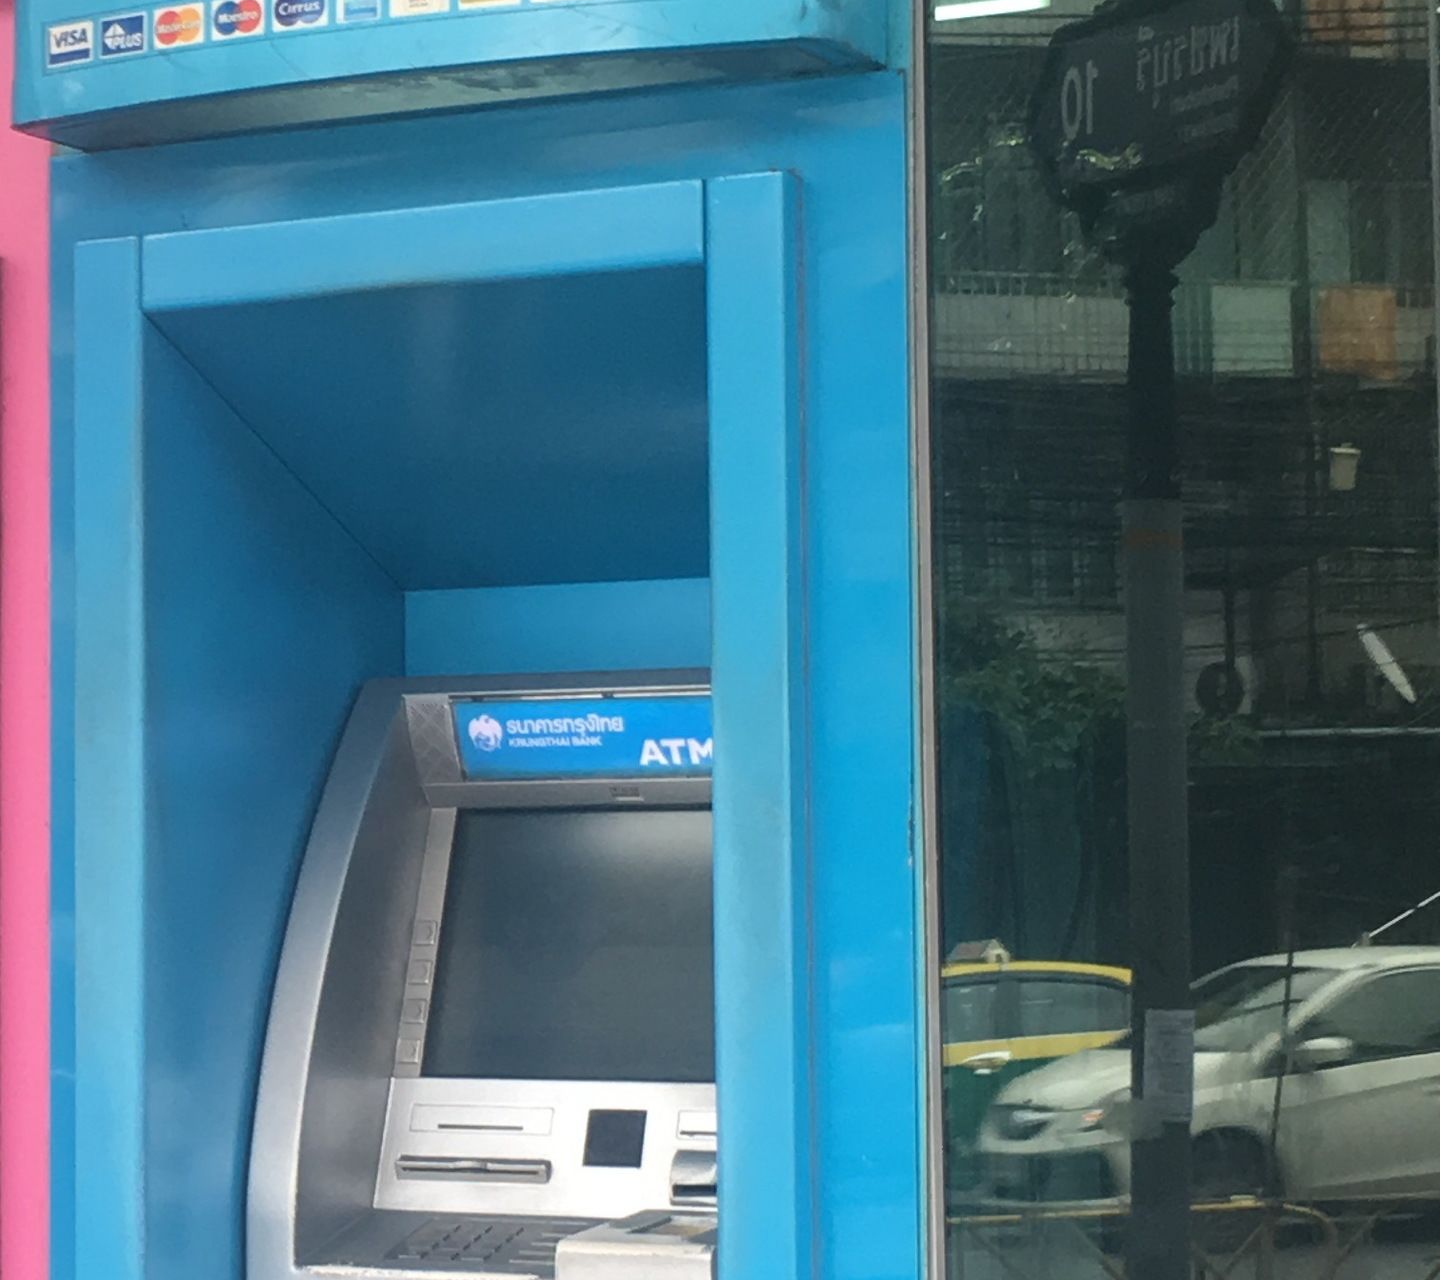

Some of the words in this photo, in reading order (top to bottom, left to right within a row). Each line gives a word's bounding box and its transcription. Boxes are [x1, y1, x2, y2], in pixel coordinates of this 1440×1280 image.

[278, 0, 321, 17] Cirrus
[51, 29, 89, 48] VISA
[506, 713, 624, 735] ธนาคารกรุงไทย
[572, 735, 602, 747] BANK
[640, 737, 712, 766] ATM
